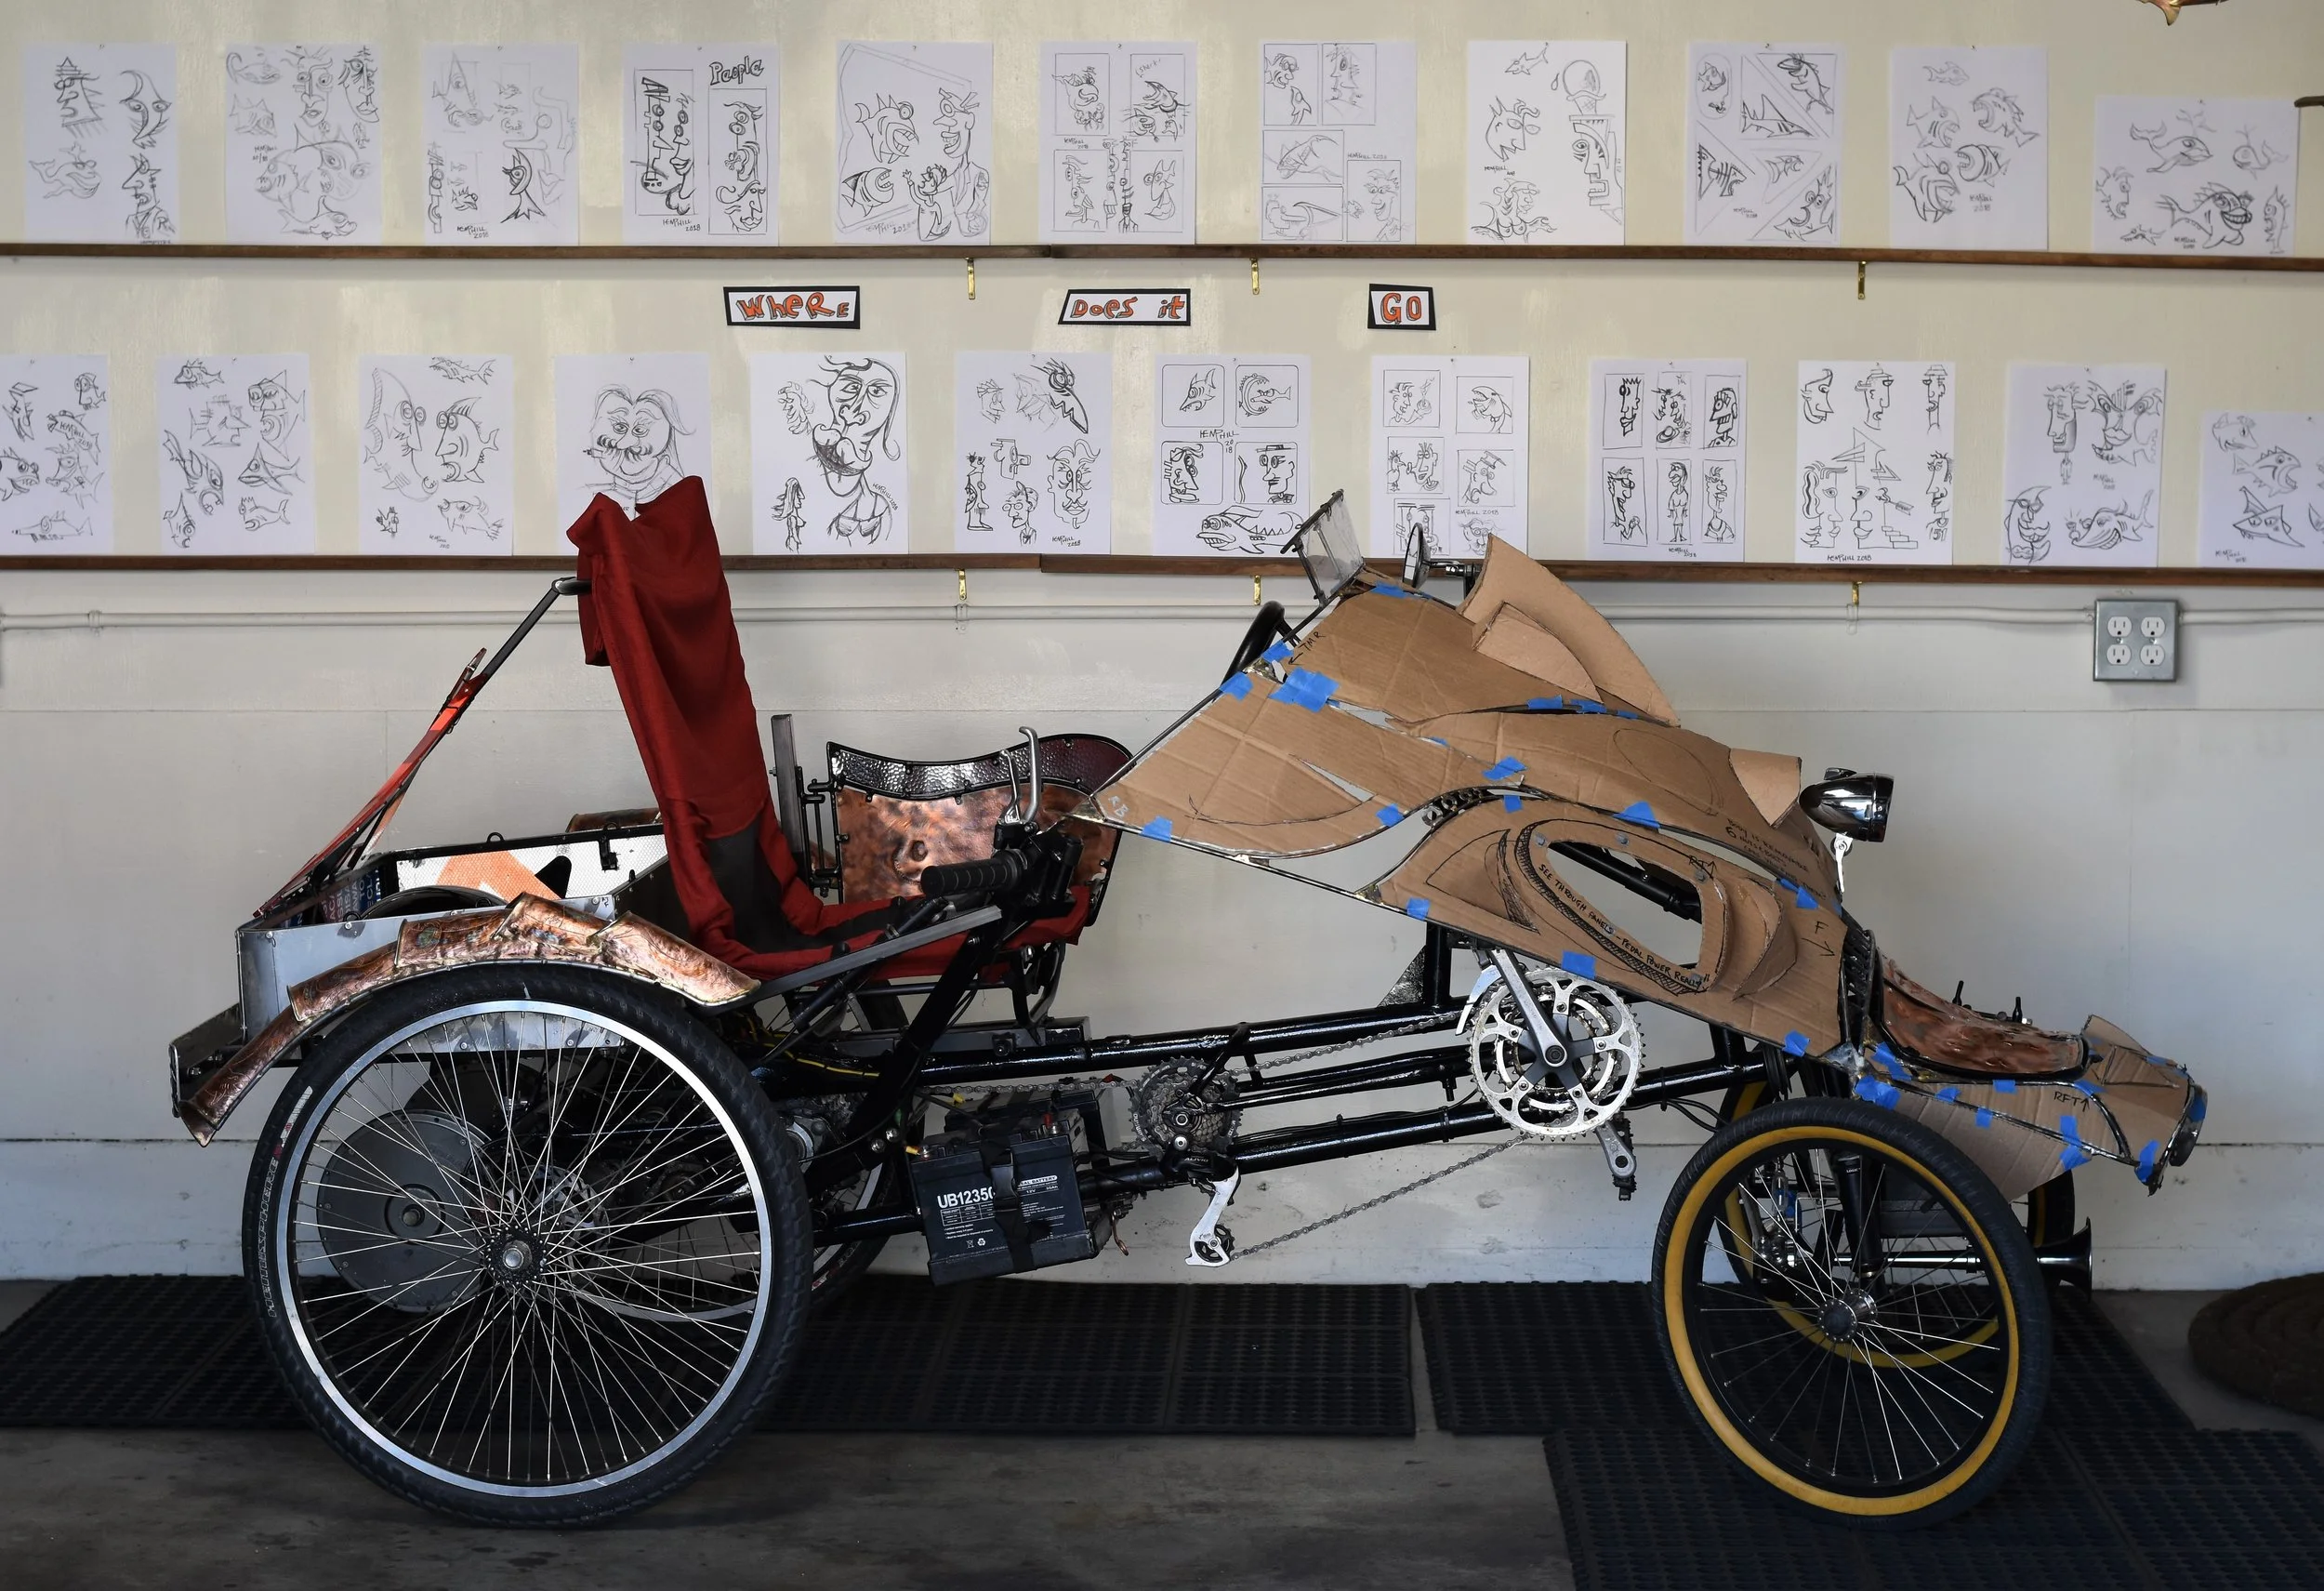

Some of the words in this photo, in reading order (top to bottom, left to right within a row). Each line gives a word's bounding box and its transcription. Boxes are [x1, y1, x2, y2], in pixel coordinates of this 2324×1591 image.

[709, 55, 764, 86] People
[1157, 296, 1186, 319] it
[1199, 429, 1239, 442] HEMPHILL
[1538, 863, 1553, 881] SEE
[1555, 879, 1588, 912] THROUGH
[1588, 911, 1615, 935] PANELS
[1645, 955, 1671, 978] POWER
[1815, 921, 1829, 935] F
[2053, 1091, 2080, 1107] RFT
